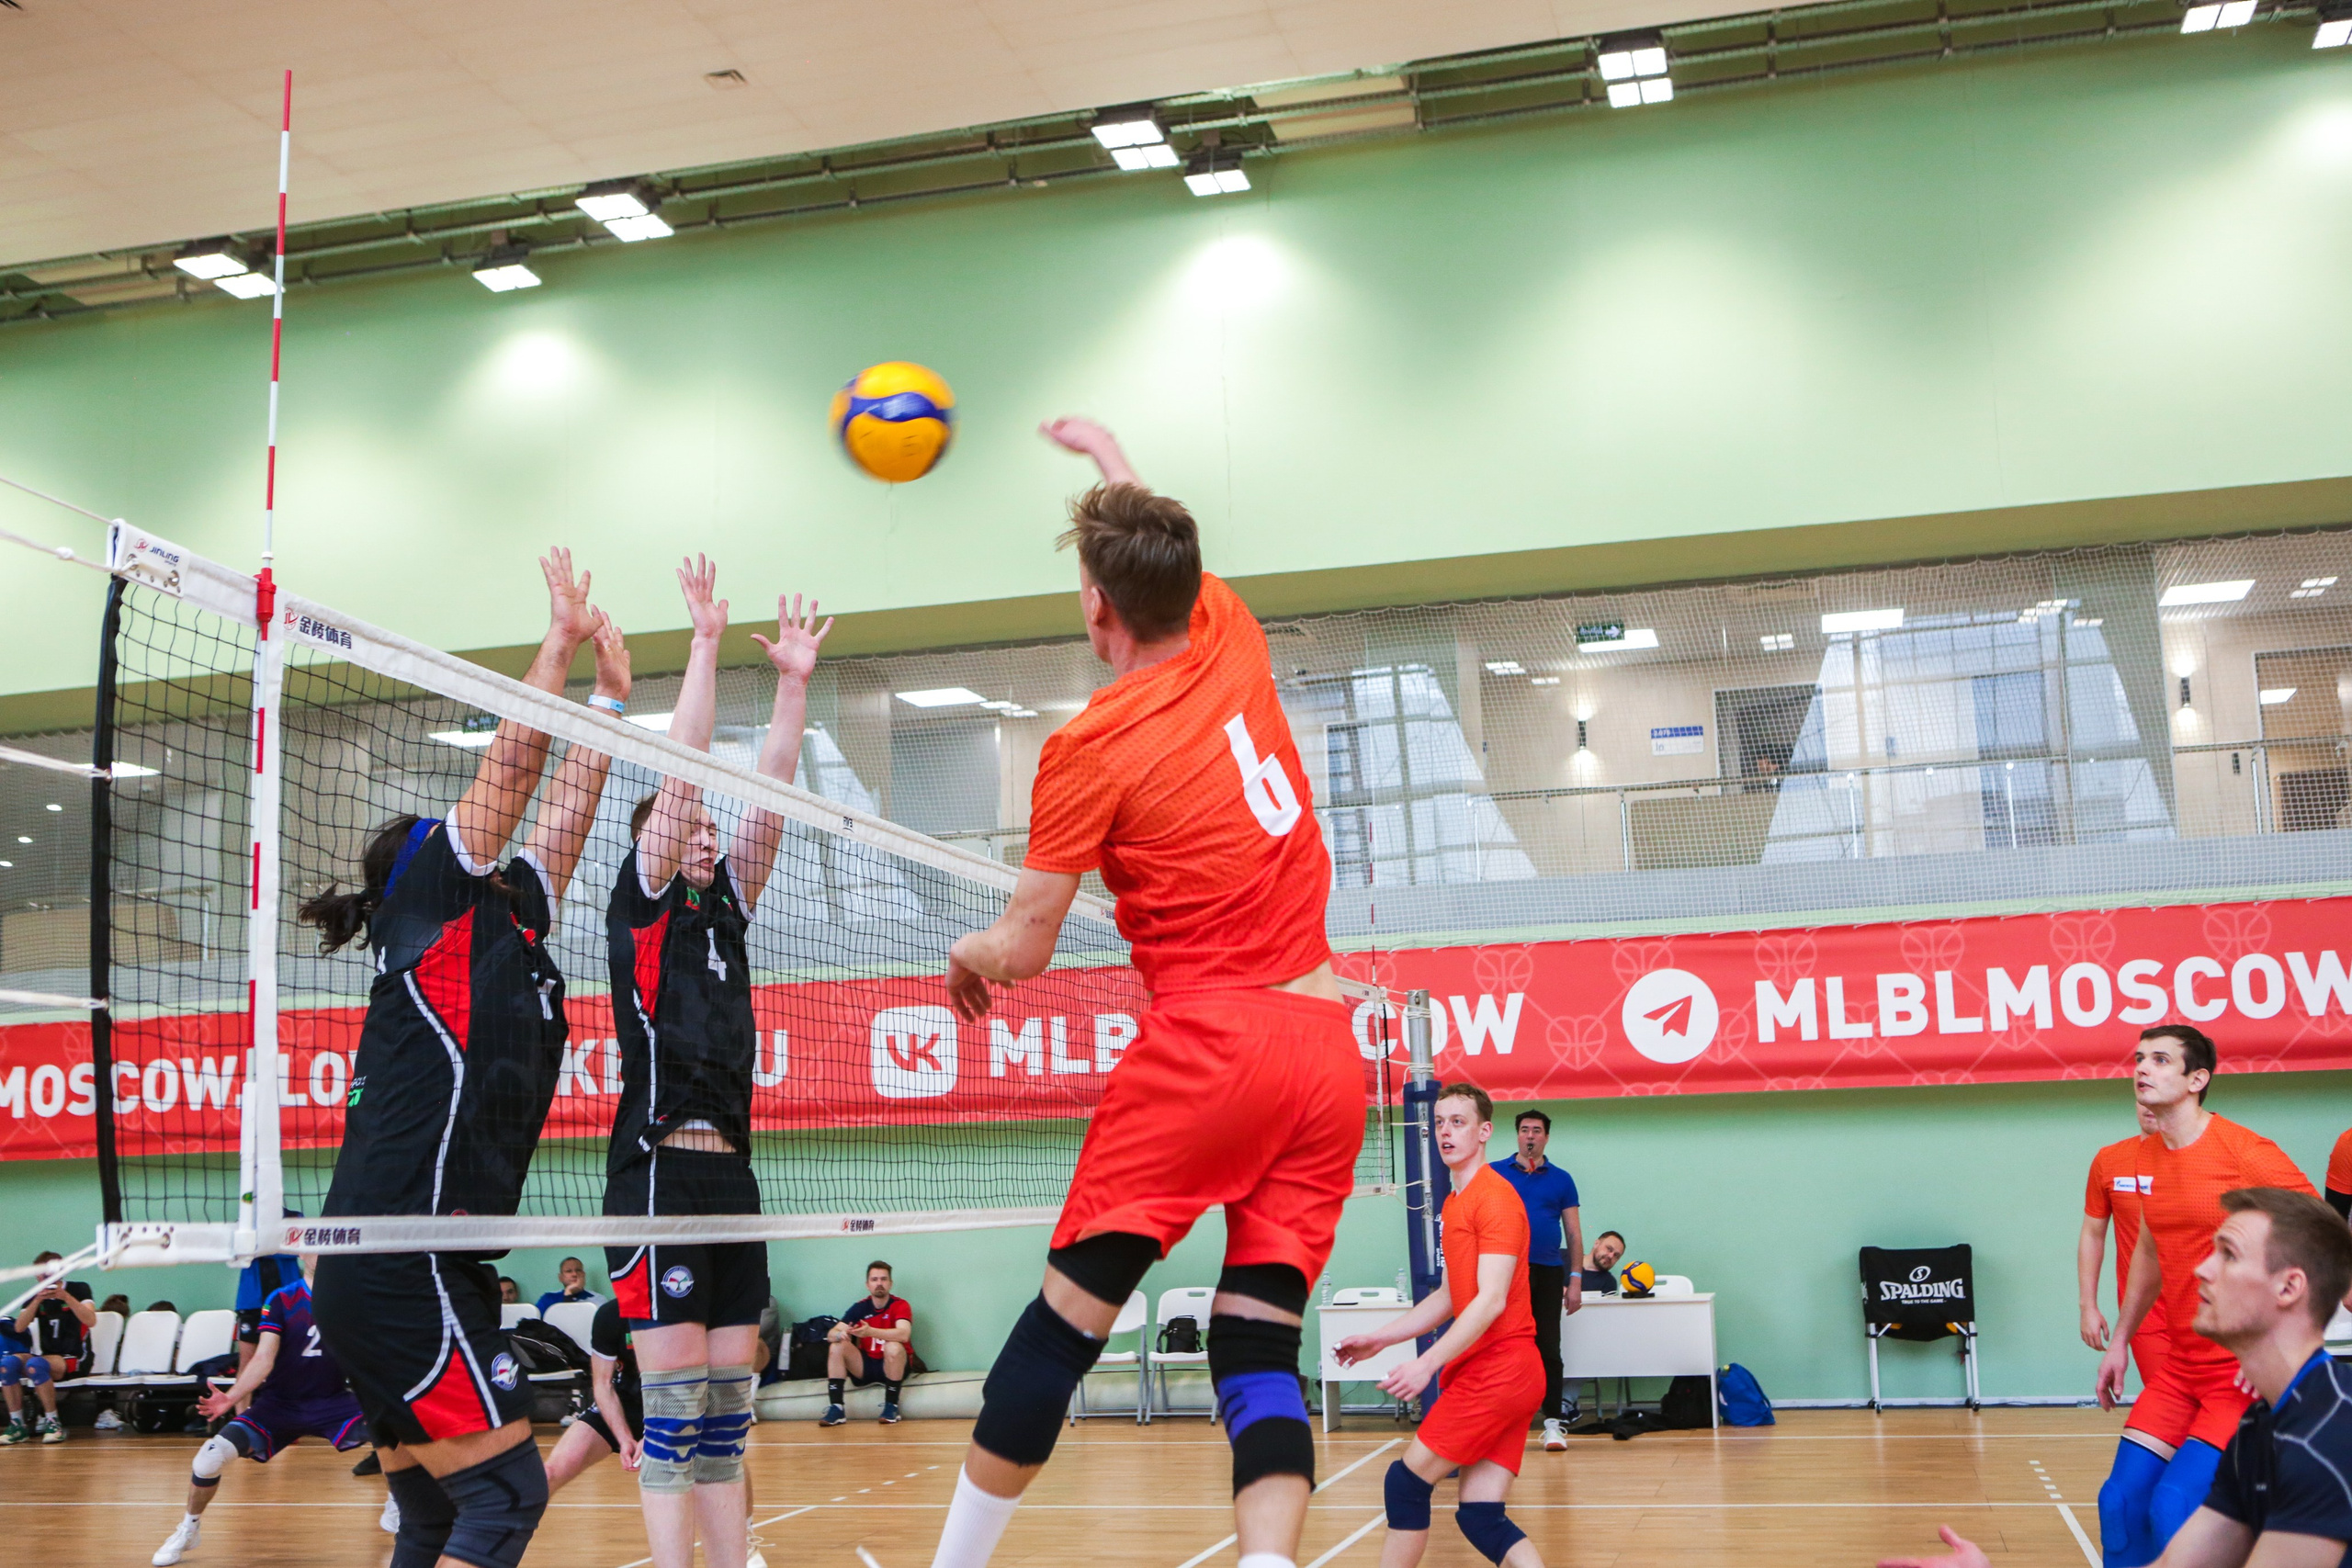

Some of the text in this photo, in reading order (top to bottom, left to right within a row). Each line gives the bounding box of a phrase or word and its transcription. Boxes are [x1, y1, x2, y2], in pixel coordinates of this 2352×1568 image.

[149, 546, 179, 563] JINLING
[299, 615, 352, 649] 金陵体育
[1223, 712, 1302, 837] 6
[707, 927, 727, 981] 4
[1754, 950, 2352, 1043] MLBLMOSCOW
[1879, 1278, 1963, 1301] SPALDING
[49, 1319, 60, 1338] 7
[301, 1325, 322, 1357] 2
